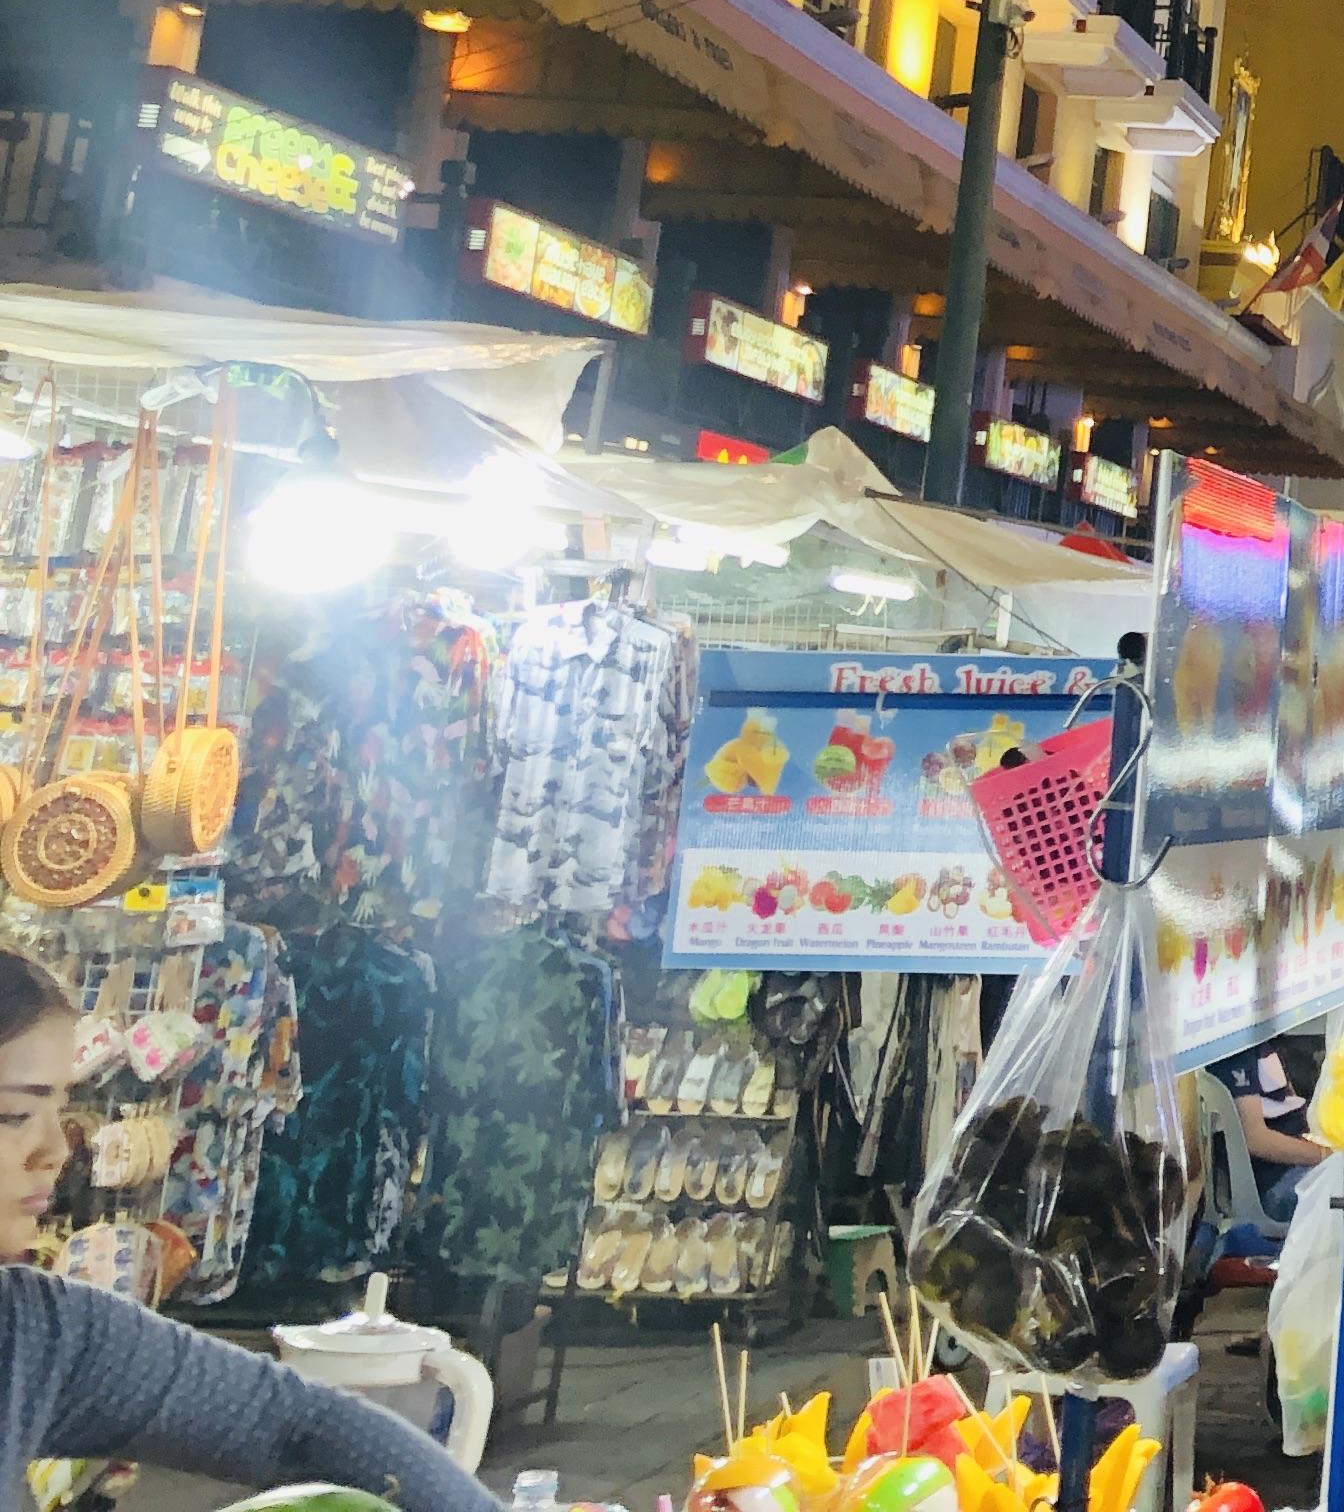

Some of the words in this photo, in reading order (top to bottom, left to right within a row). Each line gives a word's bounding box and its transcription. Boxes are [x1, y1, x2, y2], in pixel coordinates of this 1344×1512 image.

[833, 665, 937, 694] Fresh
[960, 668, 1048, 695] Juice
[735, 937, 771, 951] Dragon
[800, 938, 859, 950] Watermelon
[866, 938, 914, 952] Pineapple
[919, 939, 977, 953] Mangosteen
[981, 940, 1030, 952] Rambutan
